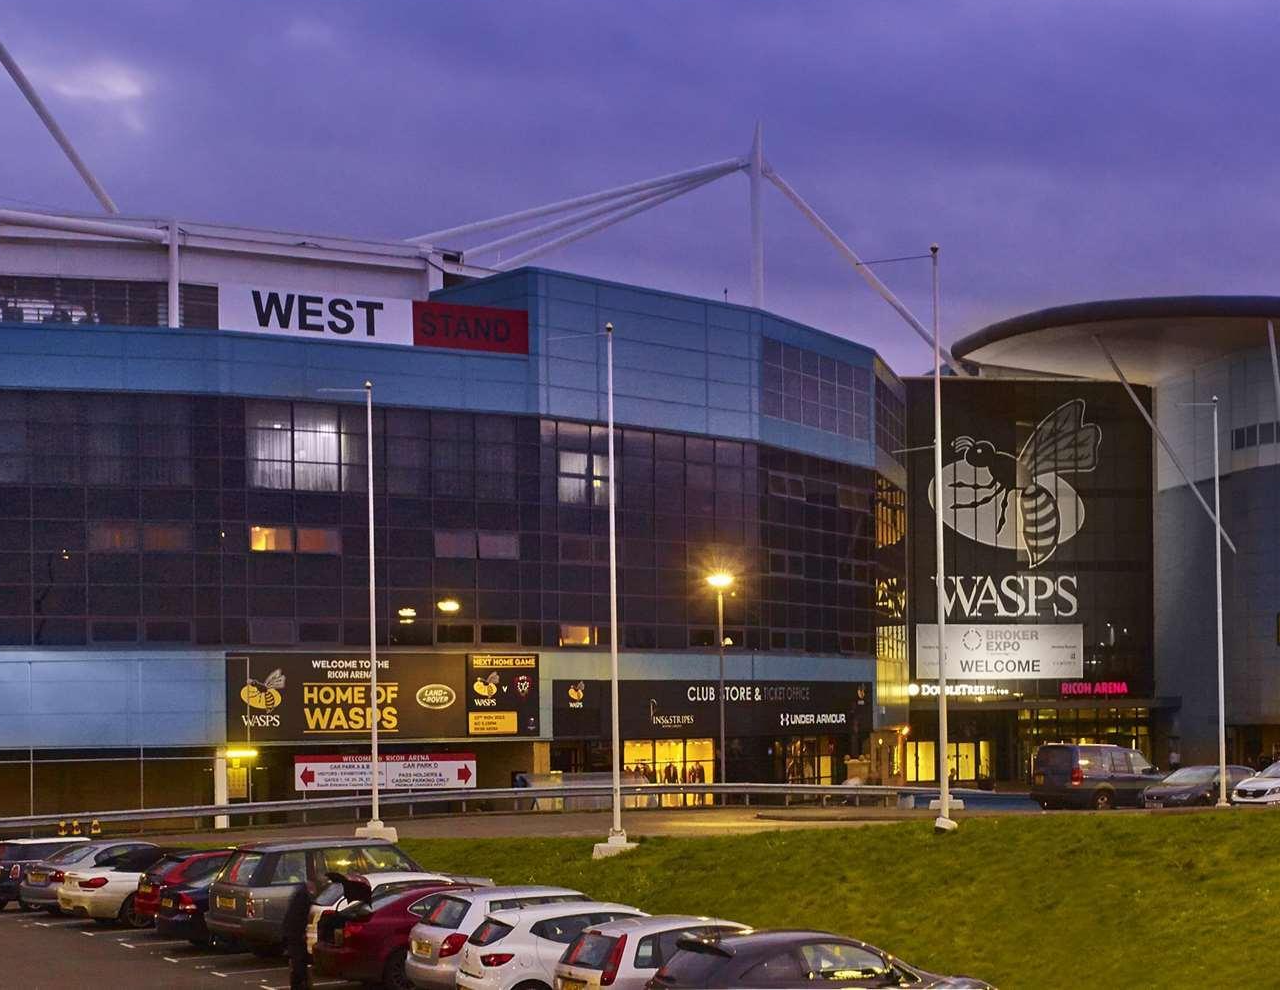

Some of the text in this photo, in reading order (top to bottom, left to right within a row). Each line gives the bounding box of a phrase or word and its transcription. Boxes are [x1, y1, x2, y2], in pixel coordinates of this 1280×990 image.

[251, 289, 510, 343] WEST STAND
[930, 575, 1078, 617] WASPS
[985, 629, 1039, 641] BROKER
[986, 641, 1020, 651] EXPO
[311, 660, 357, 669] WELCOME
[358, 660, 370, 668] TO
[473, 658, 535, 666] NEXT HOME GAME
[960, 660, 1041, 673] WELCOME
[327, 670, 349, 679] RICOH
[425, 689, 443, 697] LAND
[687, 686, 715, 702] CLUB
[754, 687, 762, 701] &
[1061, 681, 1128, 695] RICOH ARENA
[303, 686, 365, 704] HOME
[241, 714, 281, 727] WASPS
[304, 707, 398, 730] WASPS
[790, 714, 846, 725] UNDER ARMOUR
